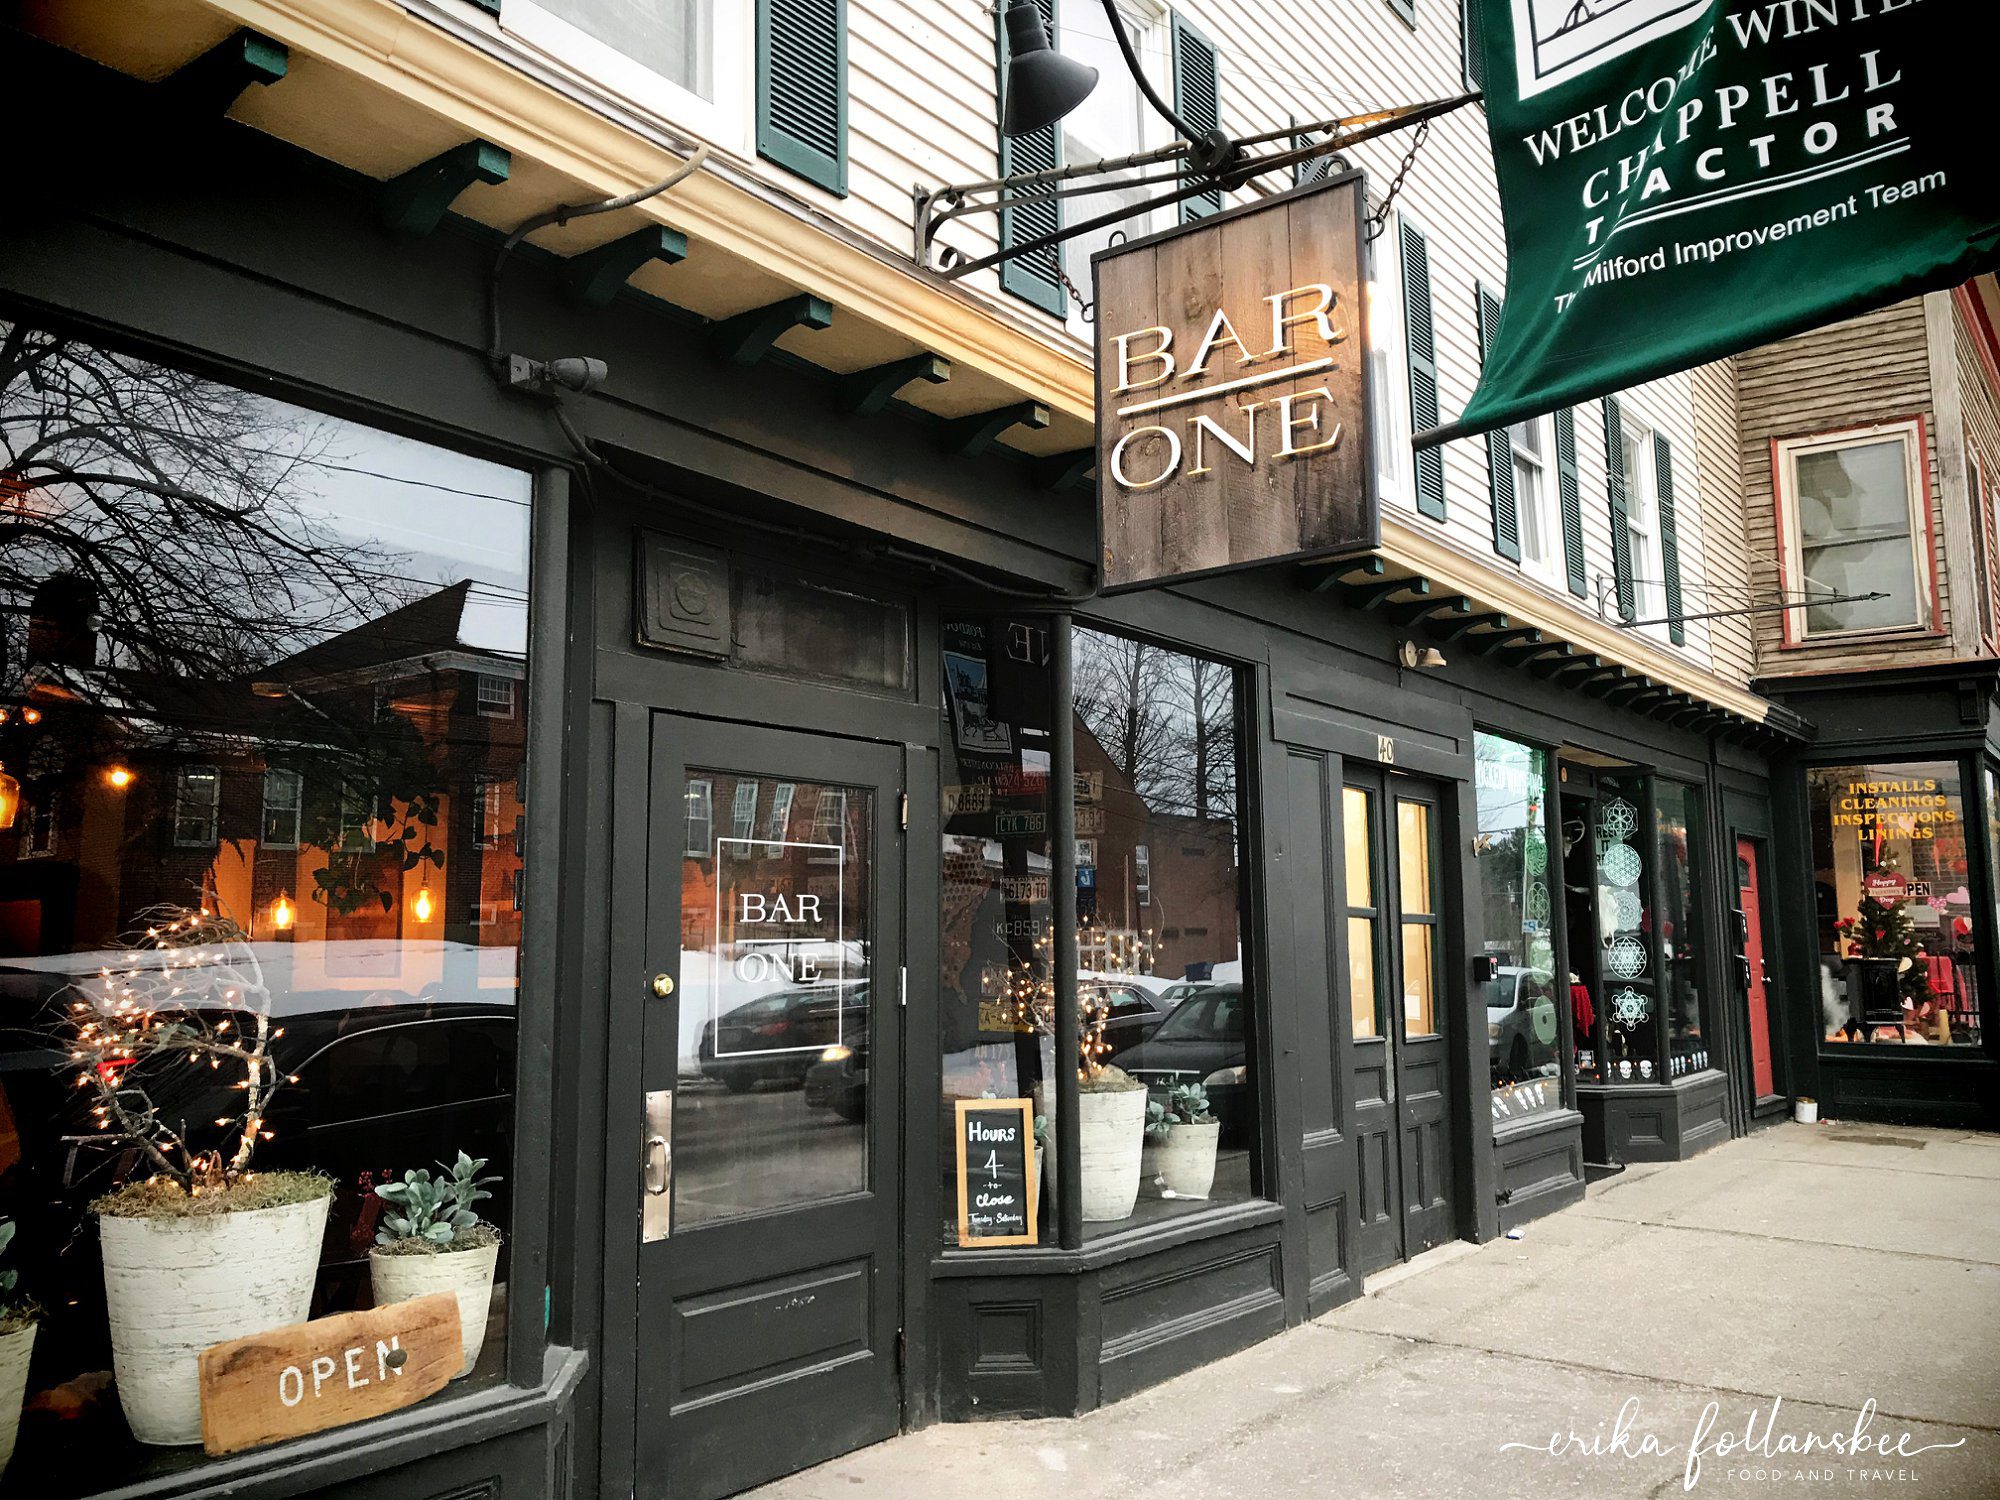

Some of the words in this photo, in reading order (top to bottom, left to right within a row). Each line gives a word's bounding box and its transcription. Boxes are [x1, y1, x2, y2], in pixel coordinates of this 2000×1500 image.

[1726, 0, 1924, 49] WINT
[1585, 103, 1899, 245] TACTOR
[1583, 246, 1666, 289] Milford
[1674, 195, 1858, 265] Improvement
[1864, 170, 1947, 209] Team
[1109, 282, 1343, 394] BAR
[1110, 386, 1342, 488] ONE
[1849, 779, 1936, 794] INSTALLS
[1840, 794, 1947, 810] CLEANINGS
[1833, 810, 1957, 826] INSPECTIONS
[1858, 826, 1934, 841] LININGS
[1903, 882, 1930, 896] PEN
[740, 893, 823, 923] BAR
[739, 952, 822, 983] ONE
[984, 1149, 1004, 1179] 4
[279, 1335, 403, 1407] OPEN
